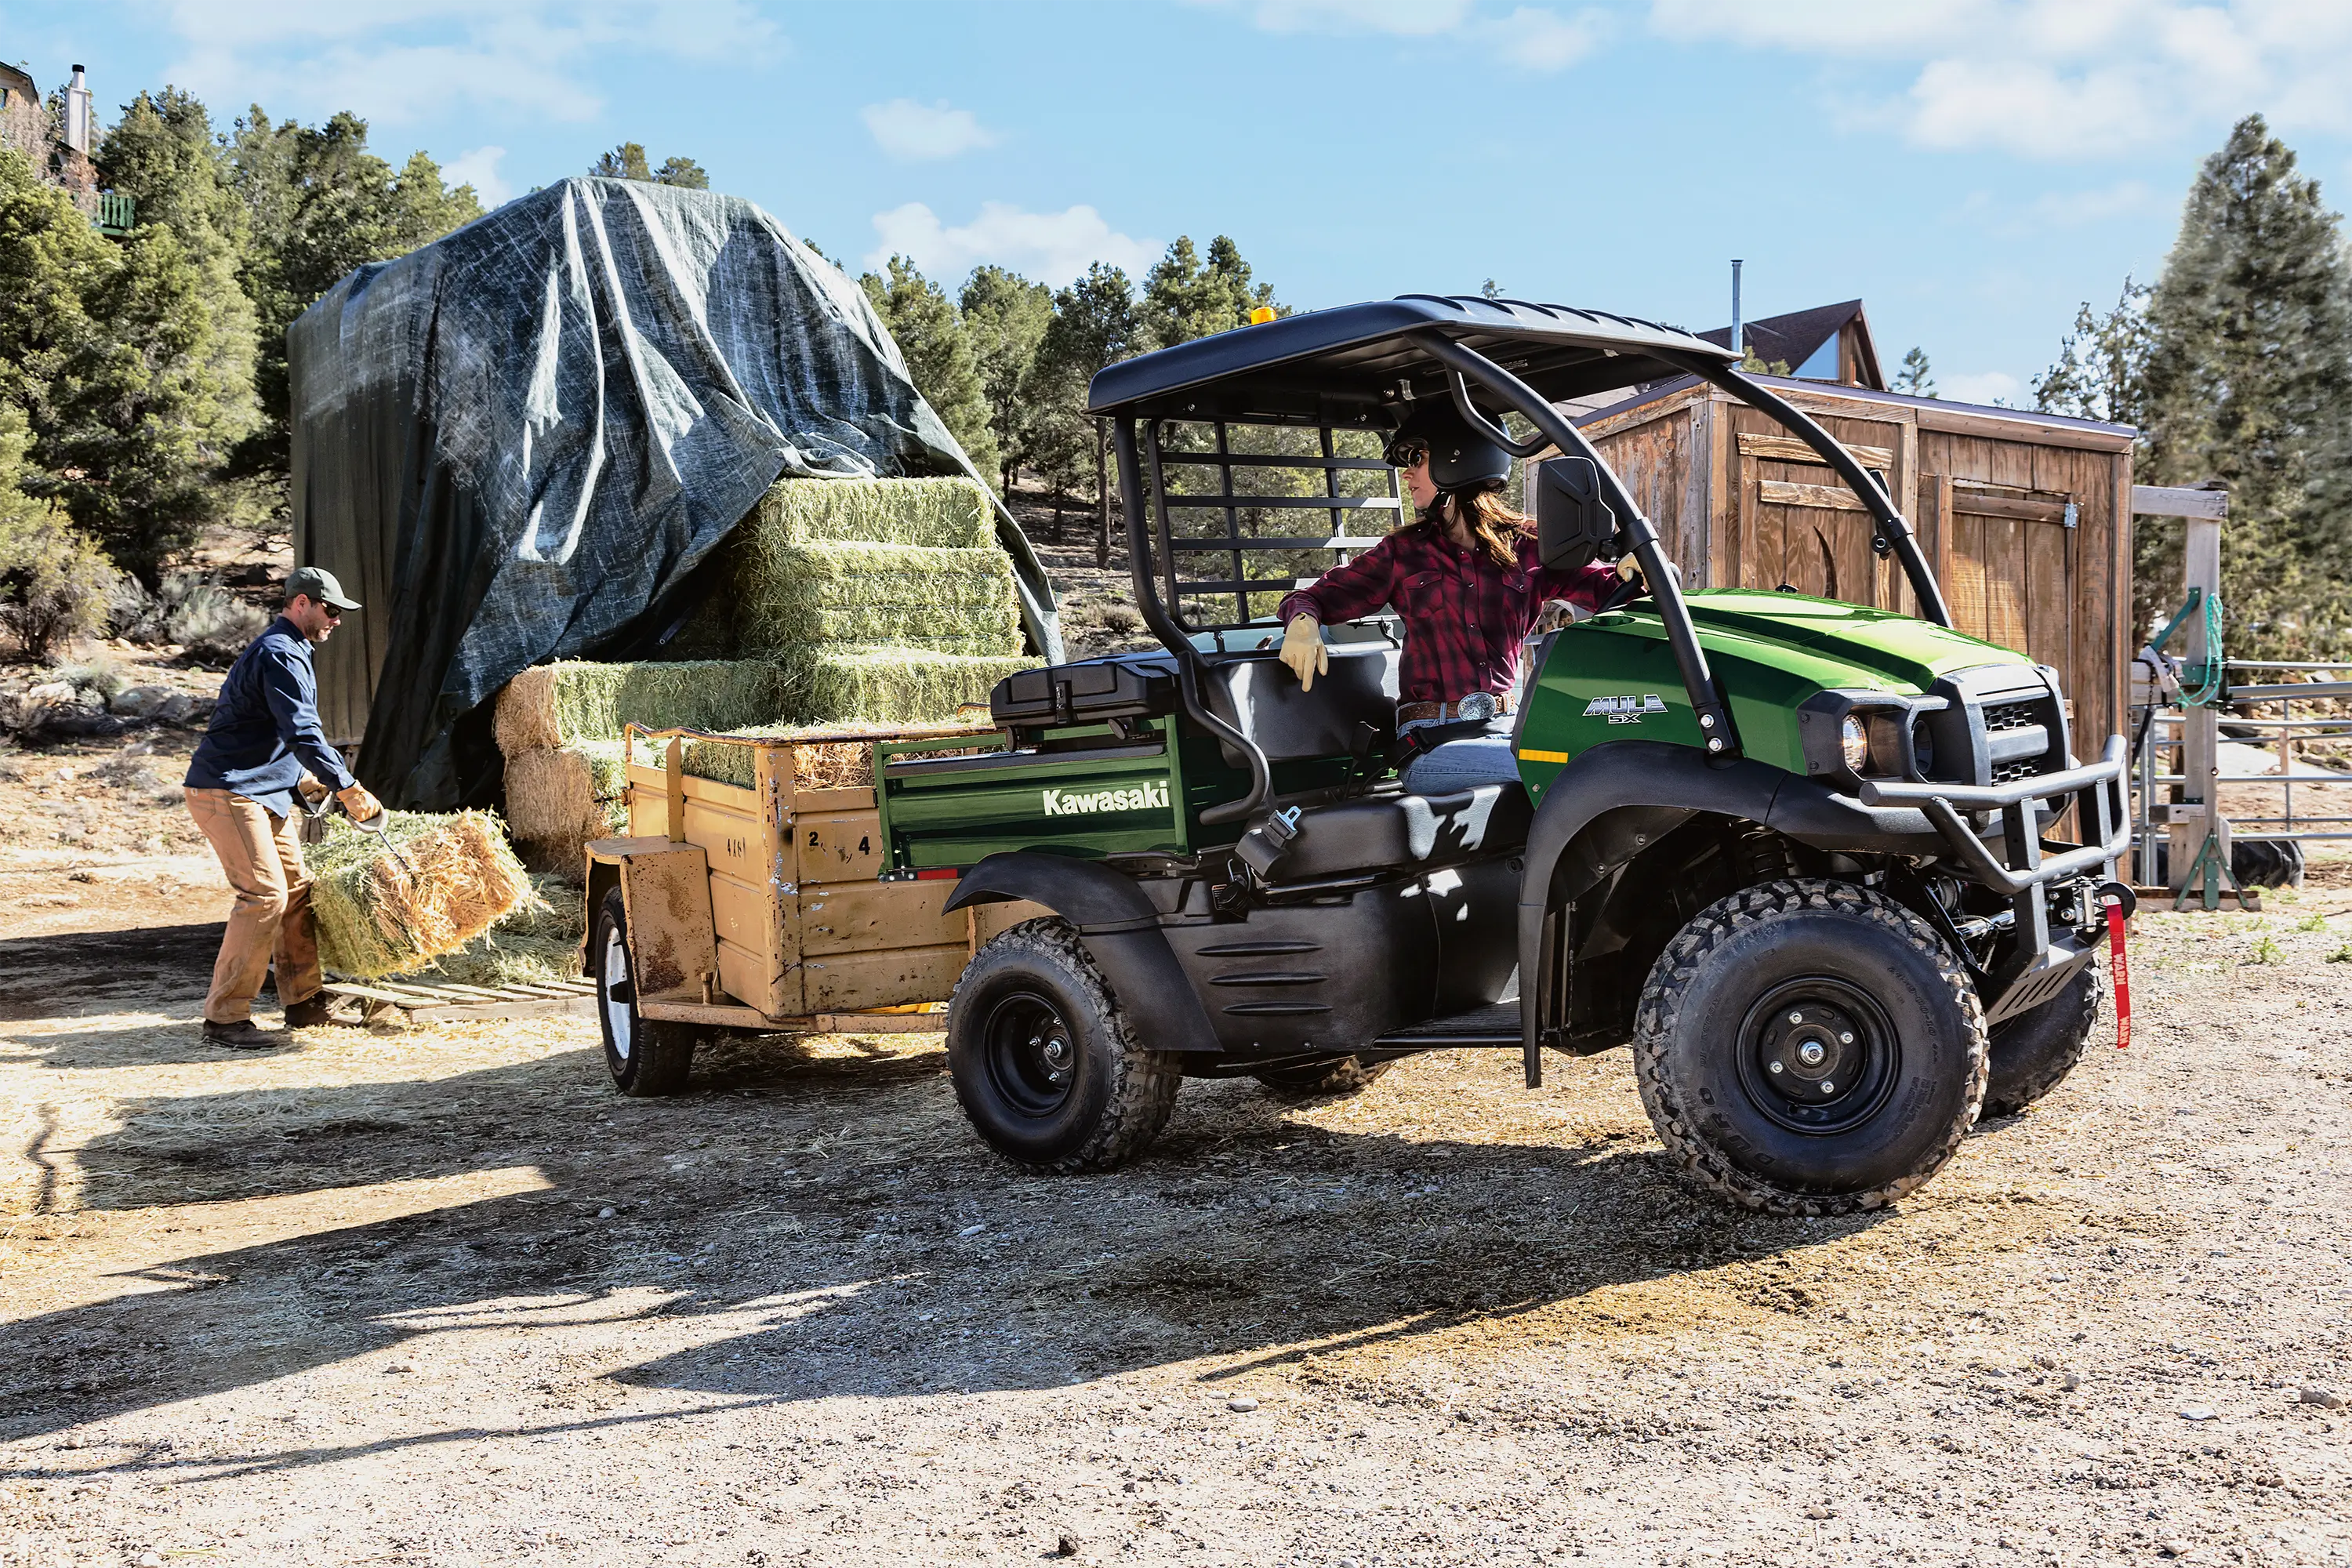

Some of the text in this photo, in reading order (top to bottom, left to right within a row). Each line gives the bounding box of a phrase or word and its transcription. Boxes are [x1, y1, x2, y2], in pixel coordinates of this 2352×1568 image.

[1582, 694, 1668, 717] MULE
[1607, 713, 1642, 724] SX
[1042, 780, 1170, 816] Kawasaki
[808, 831, 870, 855] 2 4
[2112, 953, 2127, 985] WARN
[2119, 1015, 2129, 1045] WARN
[1698, 1086, 1777, 1167] DURO
